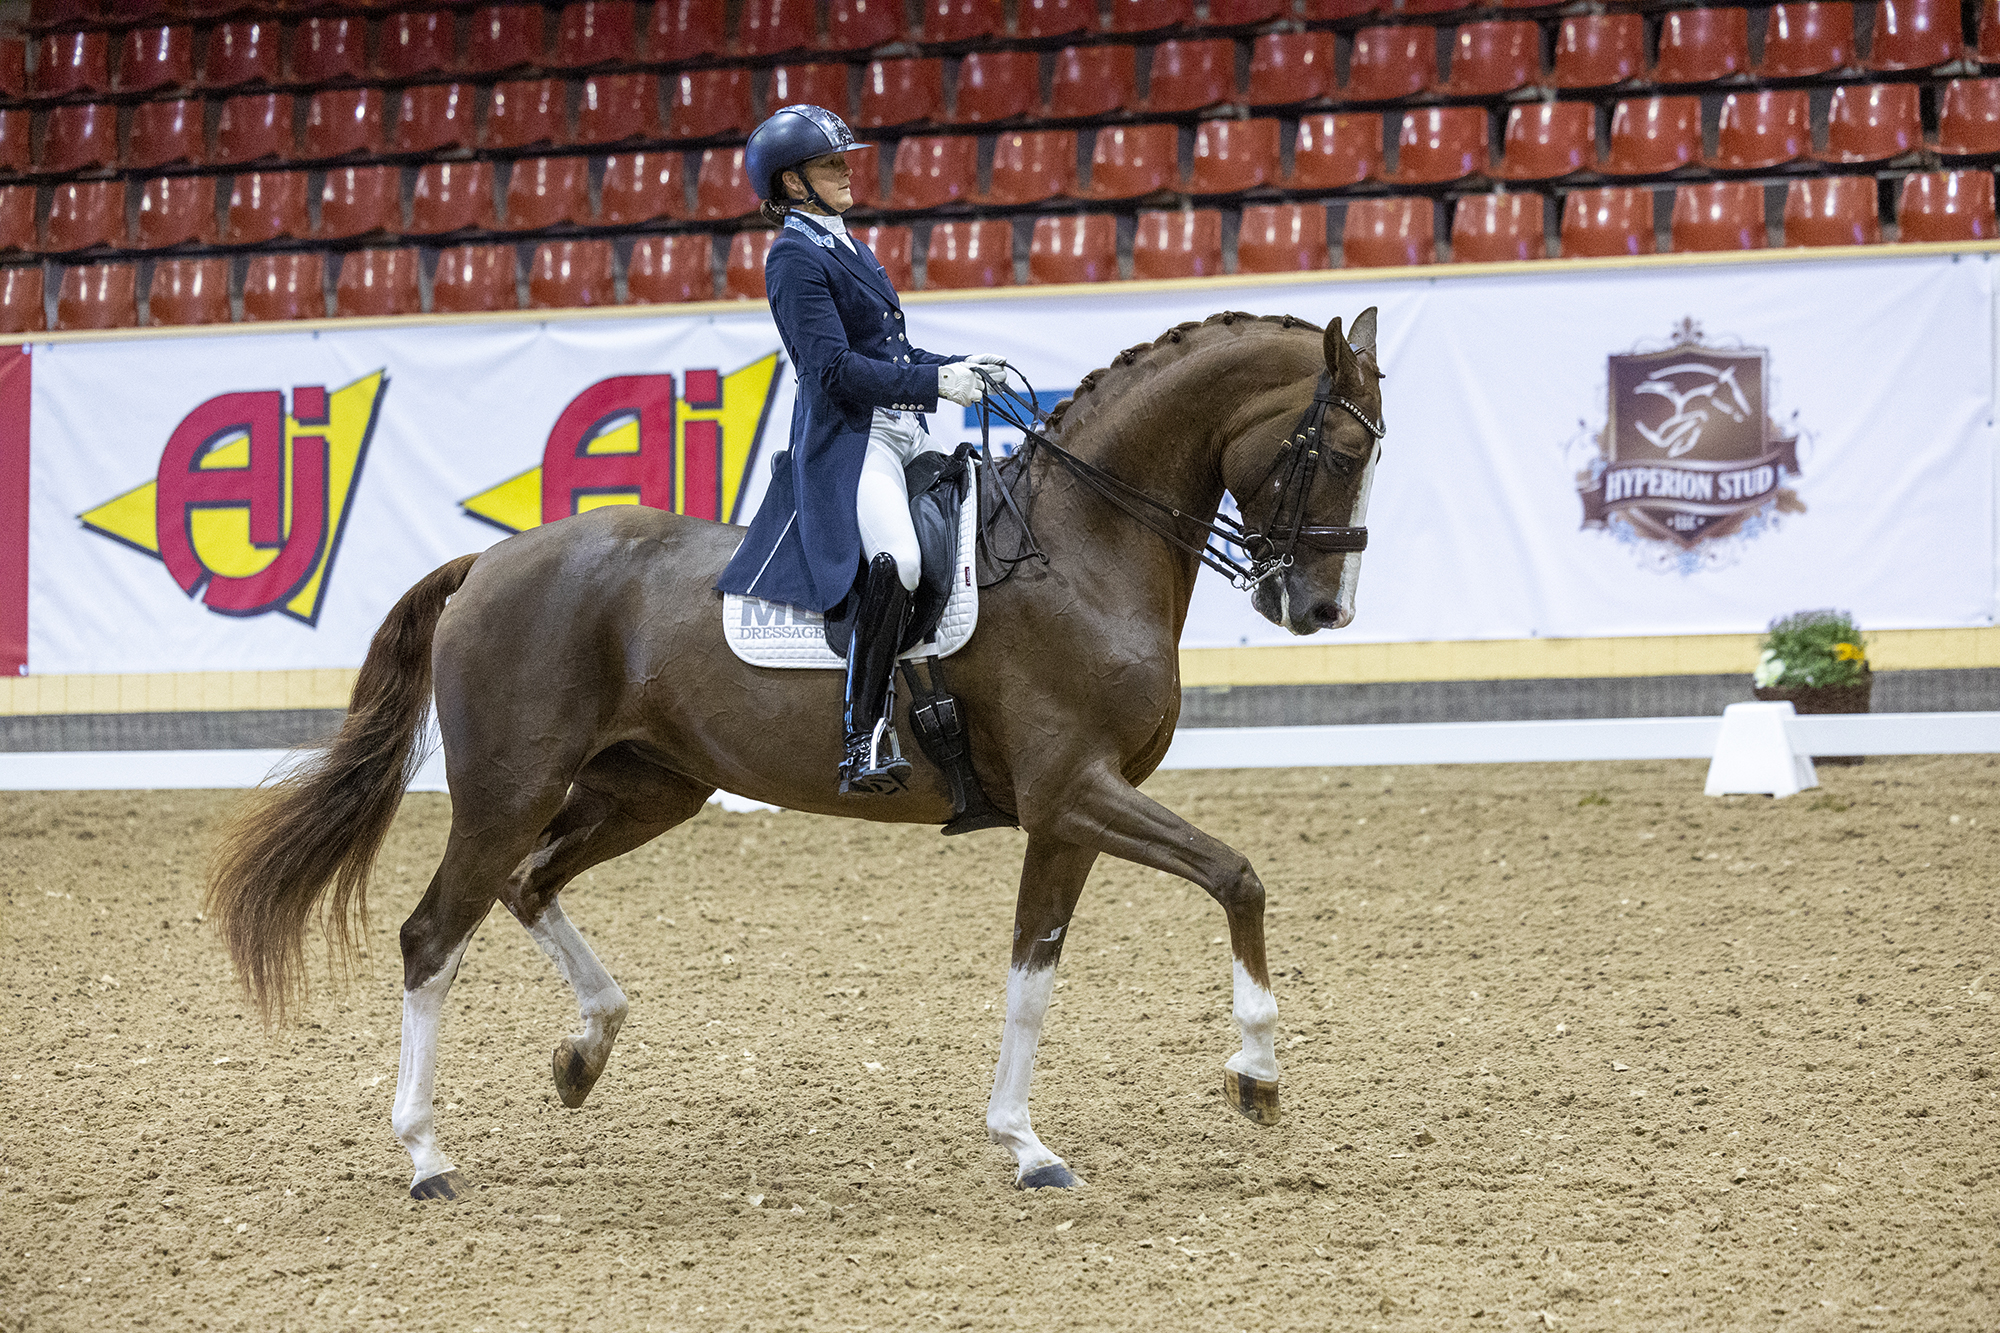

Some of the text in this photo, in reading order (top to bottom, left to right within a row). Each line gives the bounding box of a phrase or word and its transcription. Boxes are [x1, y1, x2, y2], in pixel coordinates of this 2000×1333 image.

[1605, 465, 1774, 502] HYPERION STUD
[741, 627, 825, 639] DRESSAGE
